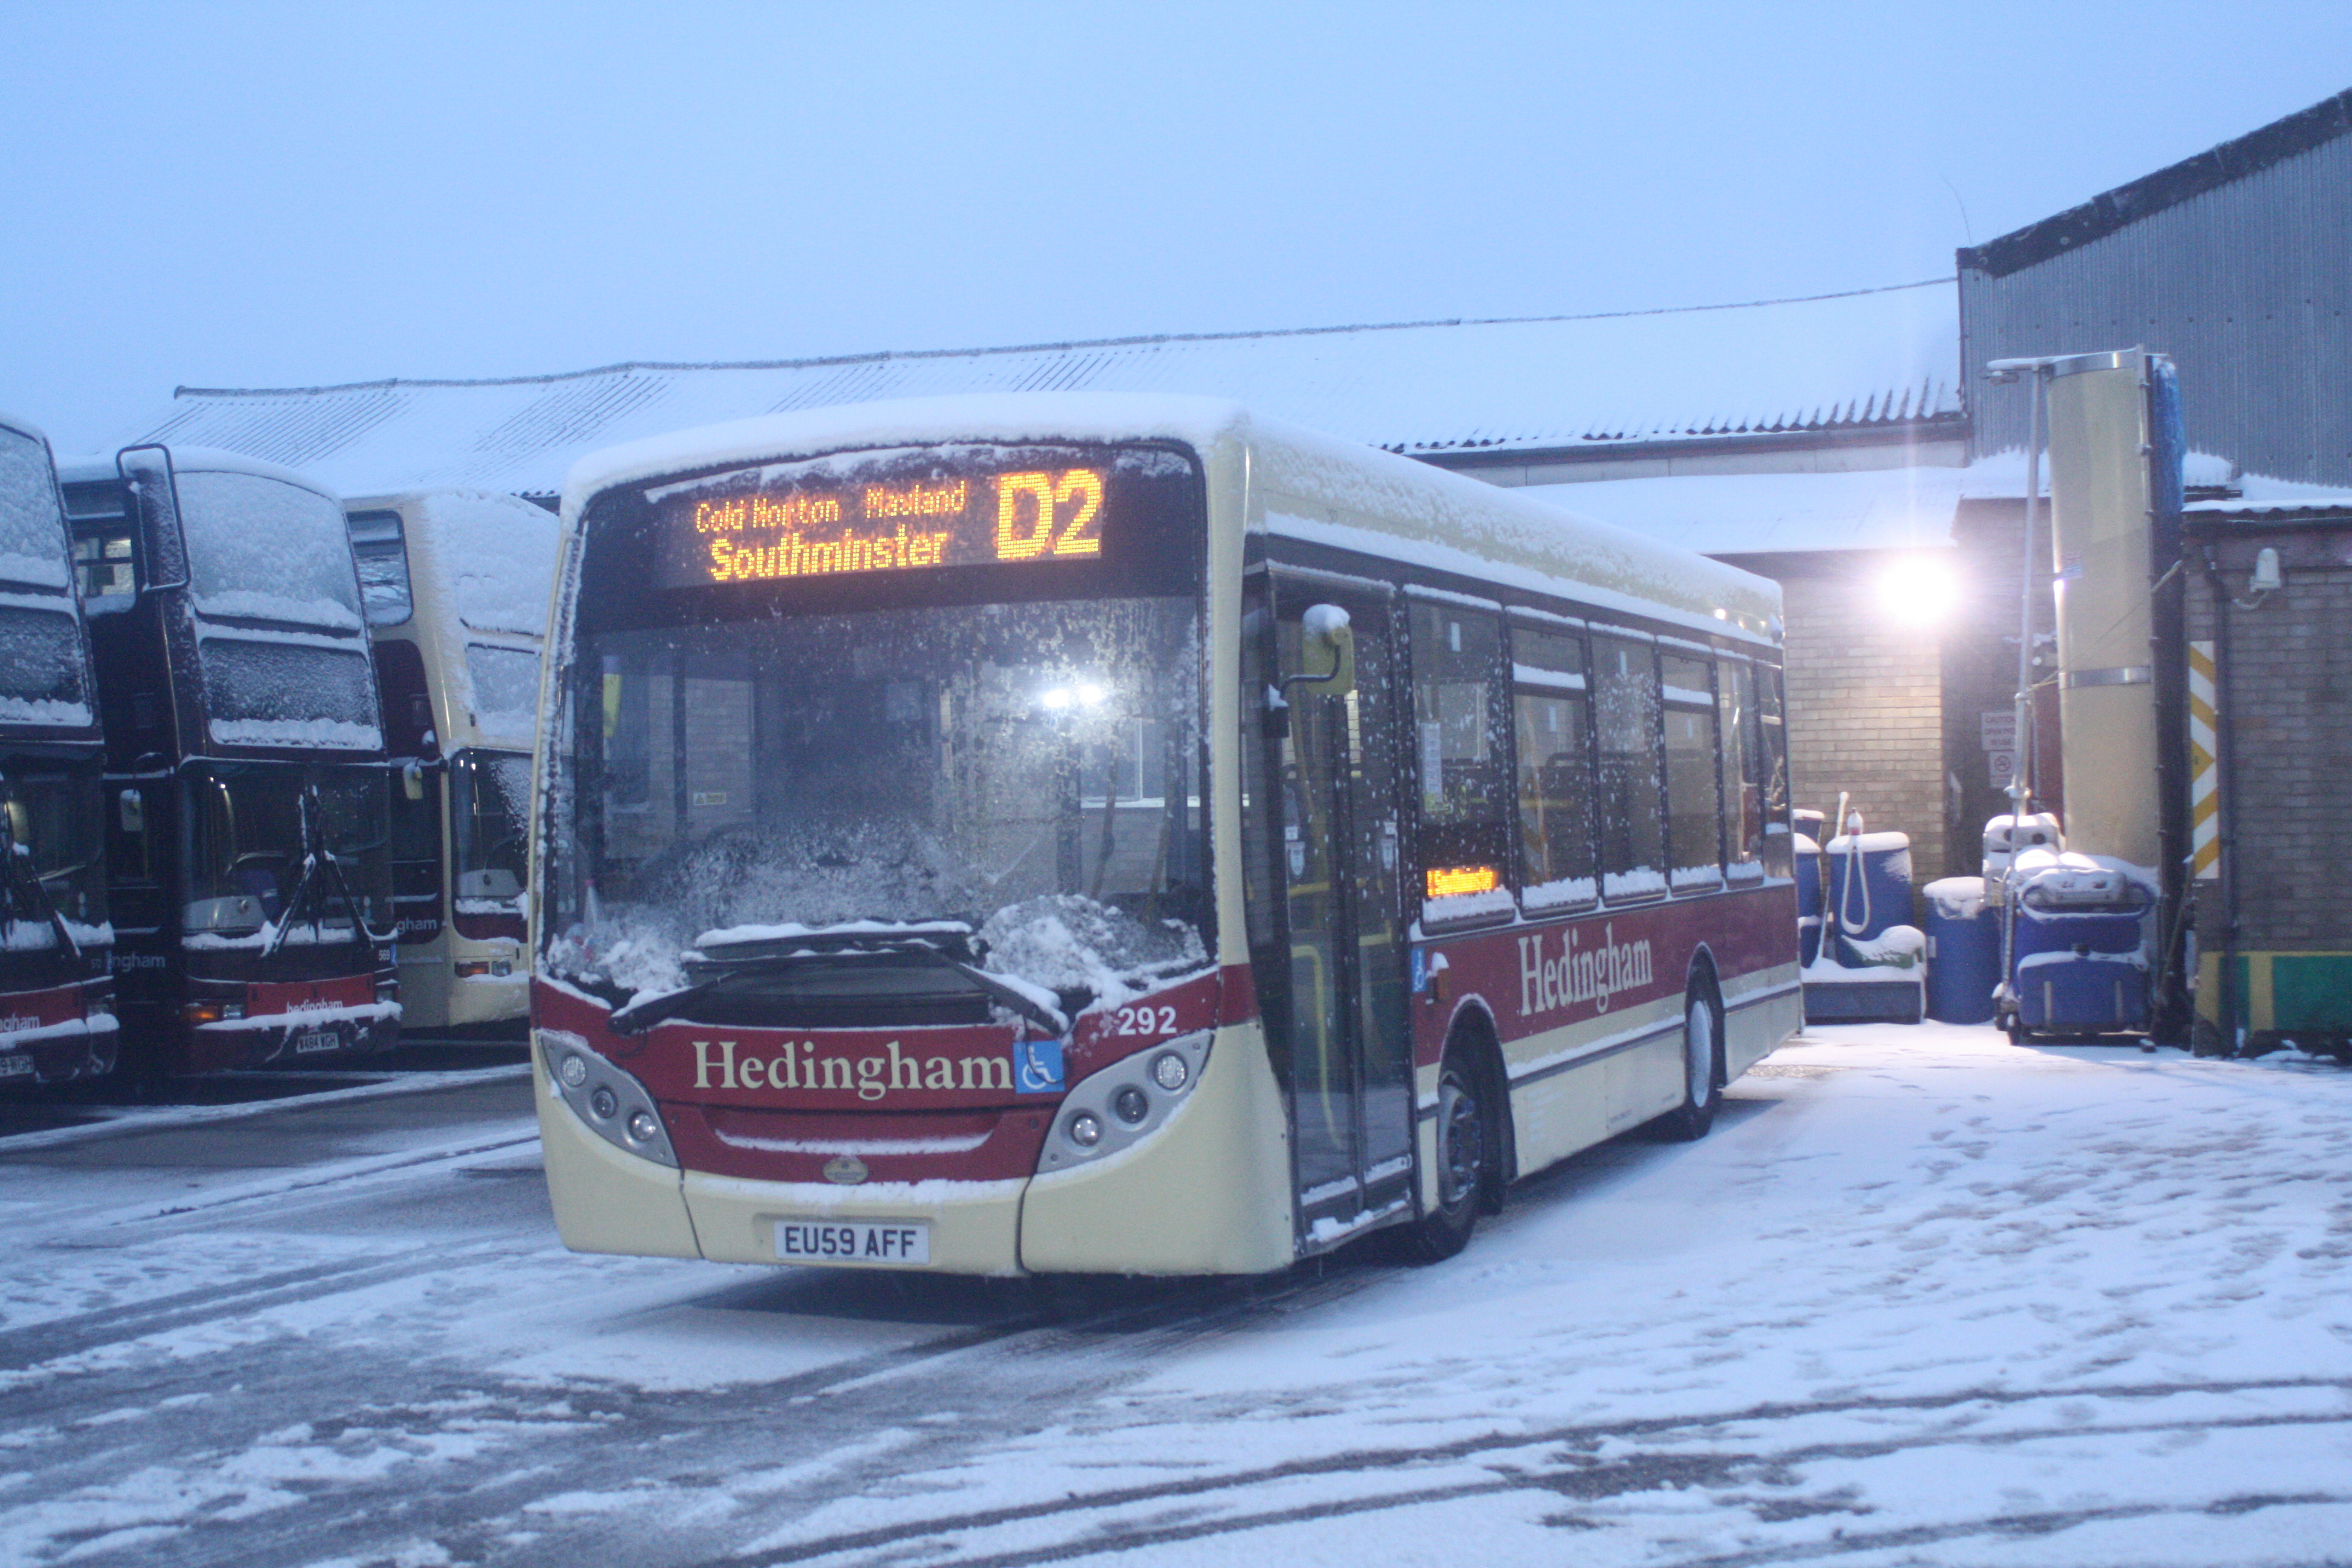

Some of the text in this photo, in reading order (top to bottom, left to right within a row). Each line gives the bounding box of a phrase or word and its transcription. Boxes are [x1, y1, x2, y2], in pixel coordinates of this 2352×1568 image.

[696, 501, 745, 533] Cold
[753, 498, 838, 528] Norton
[997, 469, 1102, 560] D2
[711, 524, 947, 581] Southminster
[1518, 922, 1653, 1016] Hedingham
[1117, 1006, 1177, 1036] 292
[692, 1040, 1013, 1100] Hedingham
[785, 1226, 916, 1257] EU59 AFF
